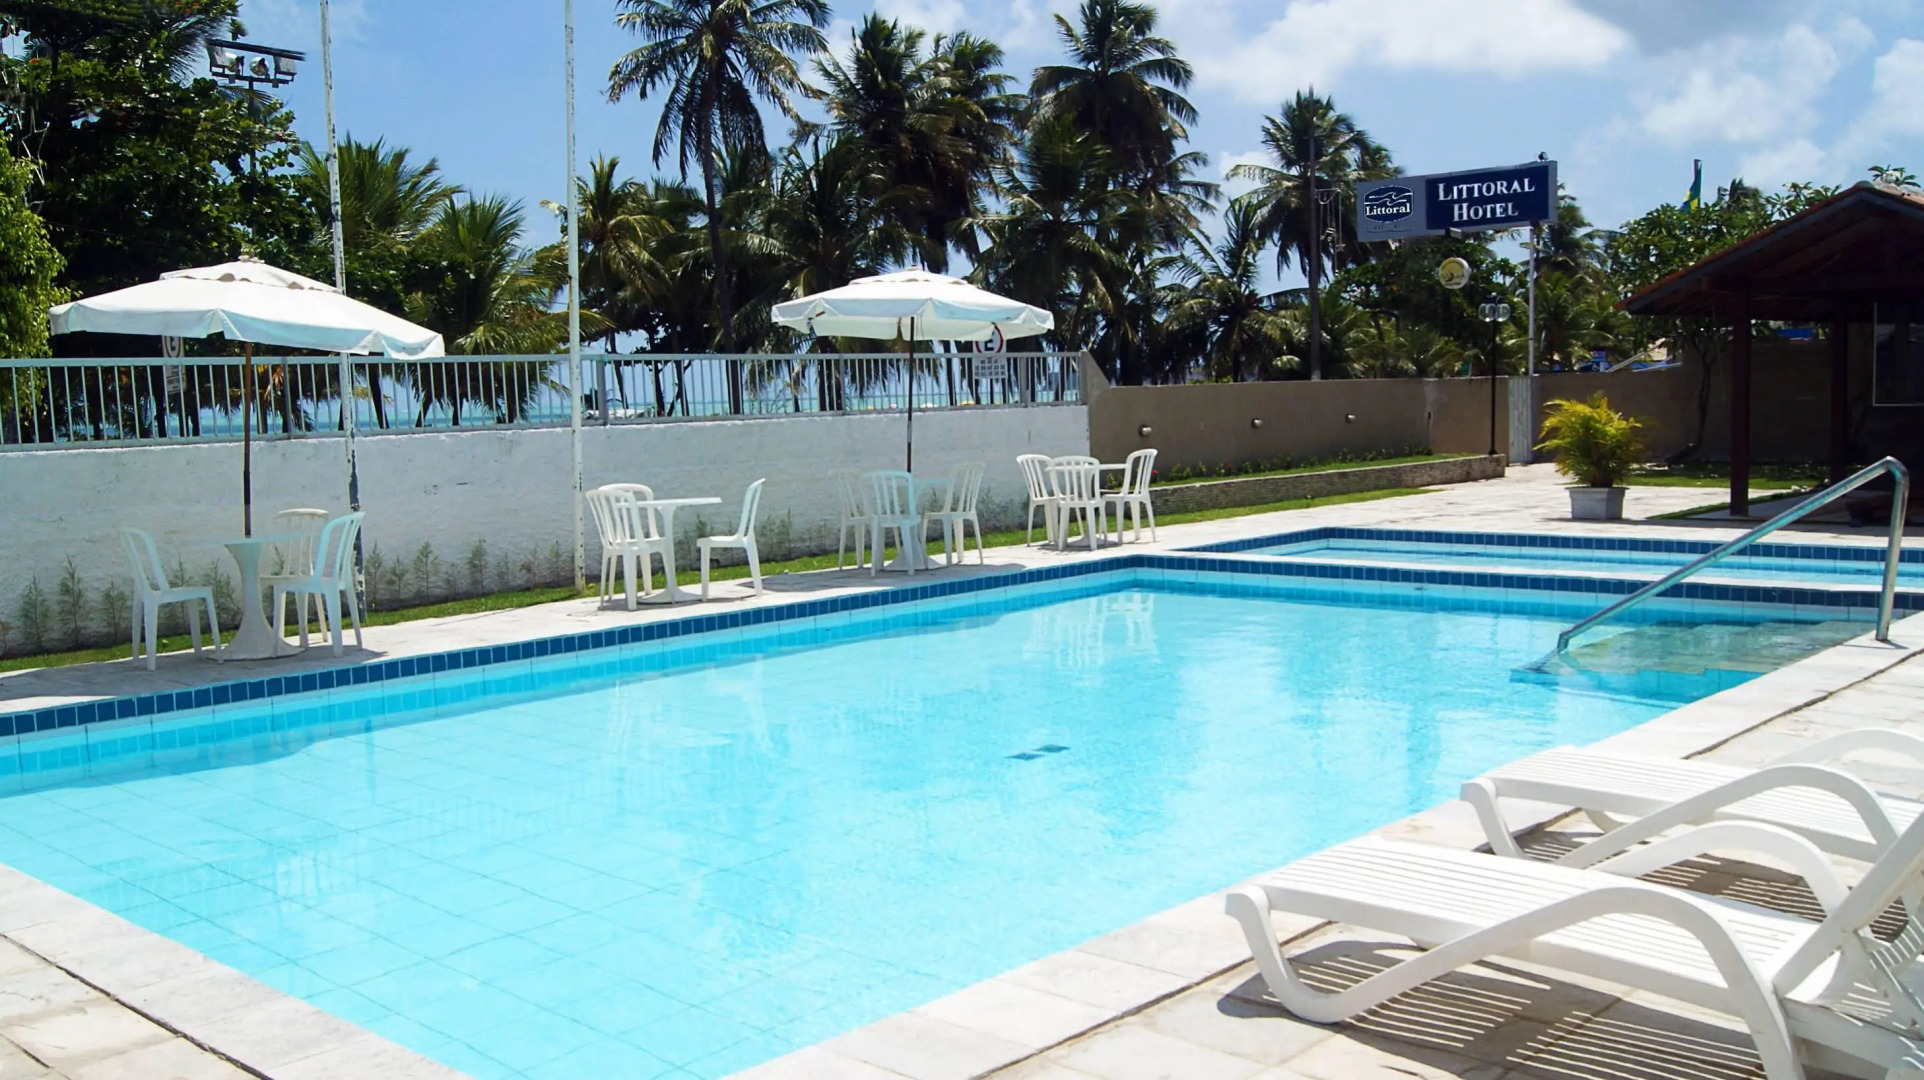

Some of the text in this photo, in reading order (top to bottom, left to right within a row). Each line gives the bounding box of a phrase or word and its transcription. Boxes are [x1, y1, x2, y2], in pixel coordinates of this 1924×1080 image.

[1438, 177, 1536, 201] LITTORAL
[1366, 203, 1411, 216] Littoral
[1453, 201, 1519, 222] HOTEL
